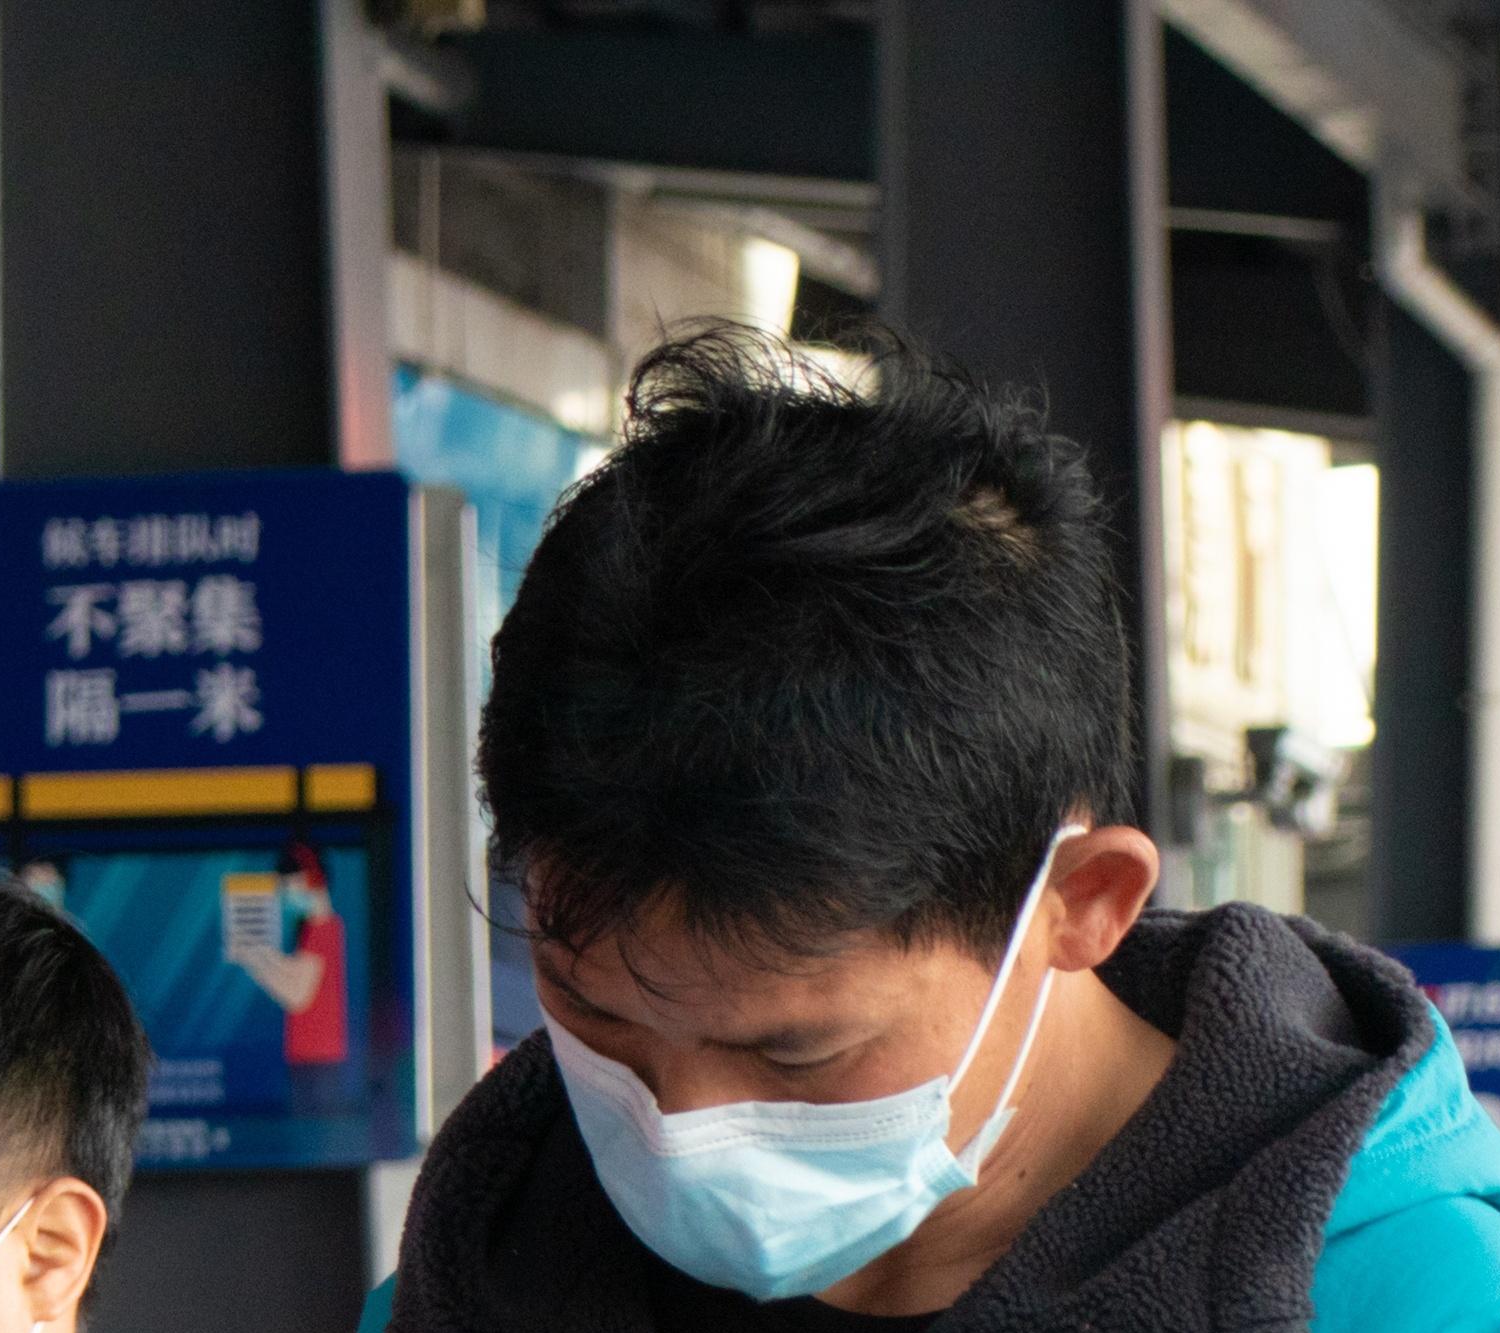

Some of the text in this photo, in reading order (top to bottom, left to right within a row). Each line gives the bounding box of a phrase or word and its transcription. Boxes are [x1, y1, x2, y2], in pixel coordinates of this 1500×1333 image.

[46, 574, 263, 659] 不聚集
[45, 662, 265, 747] 隔一米
